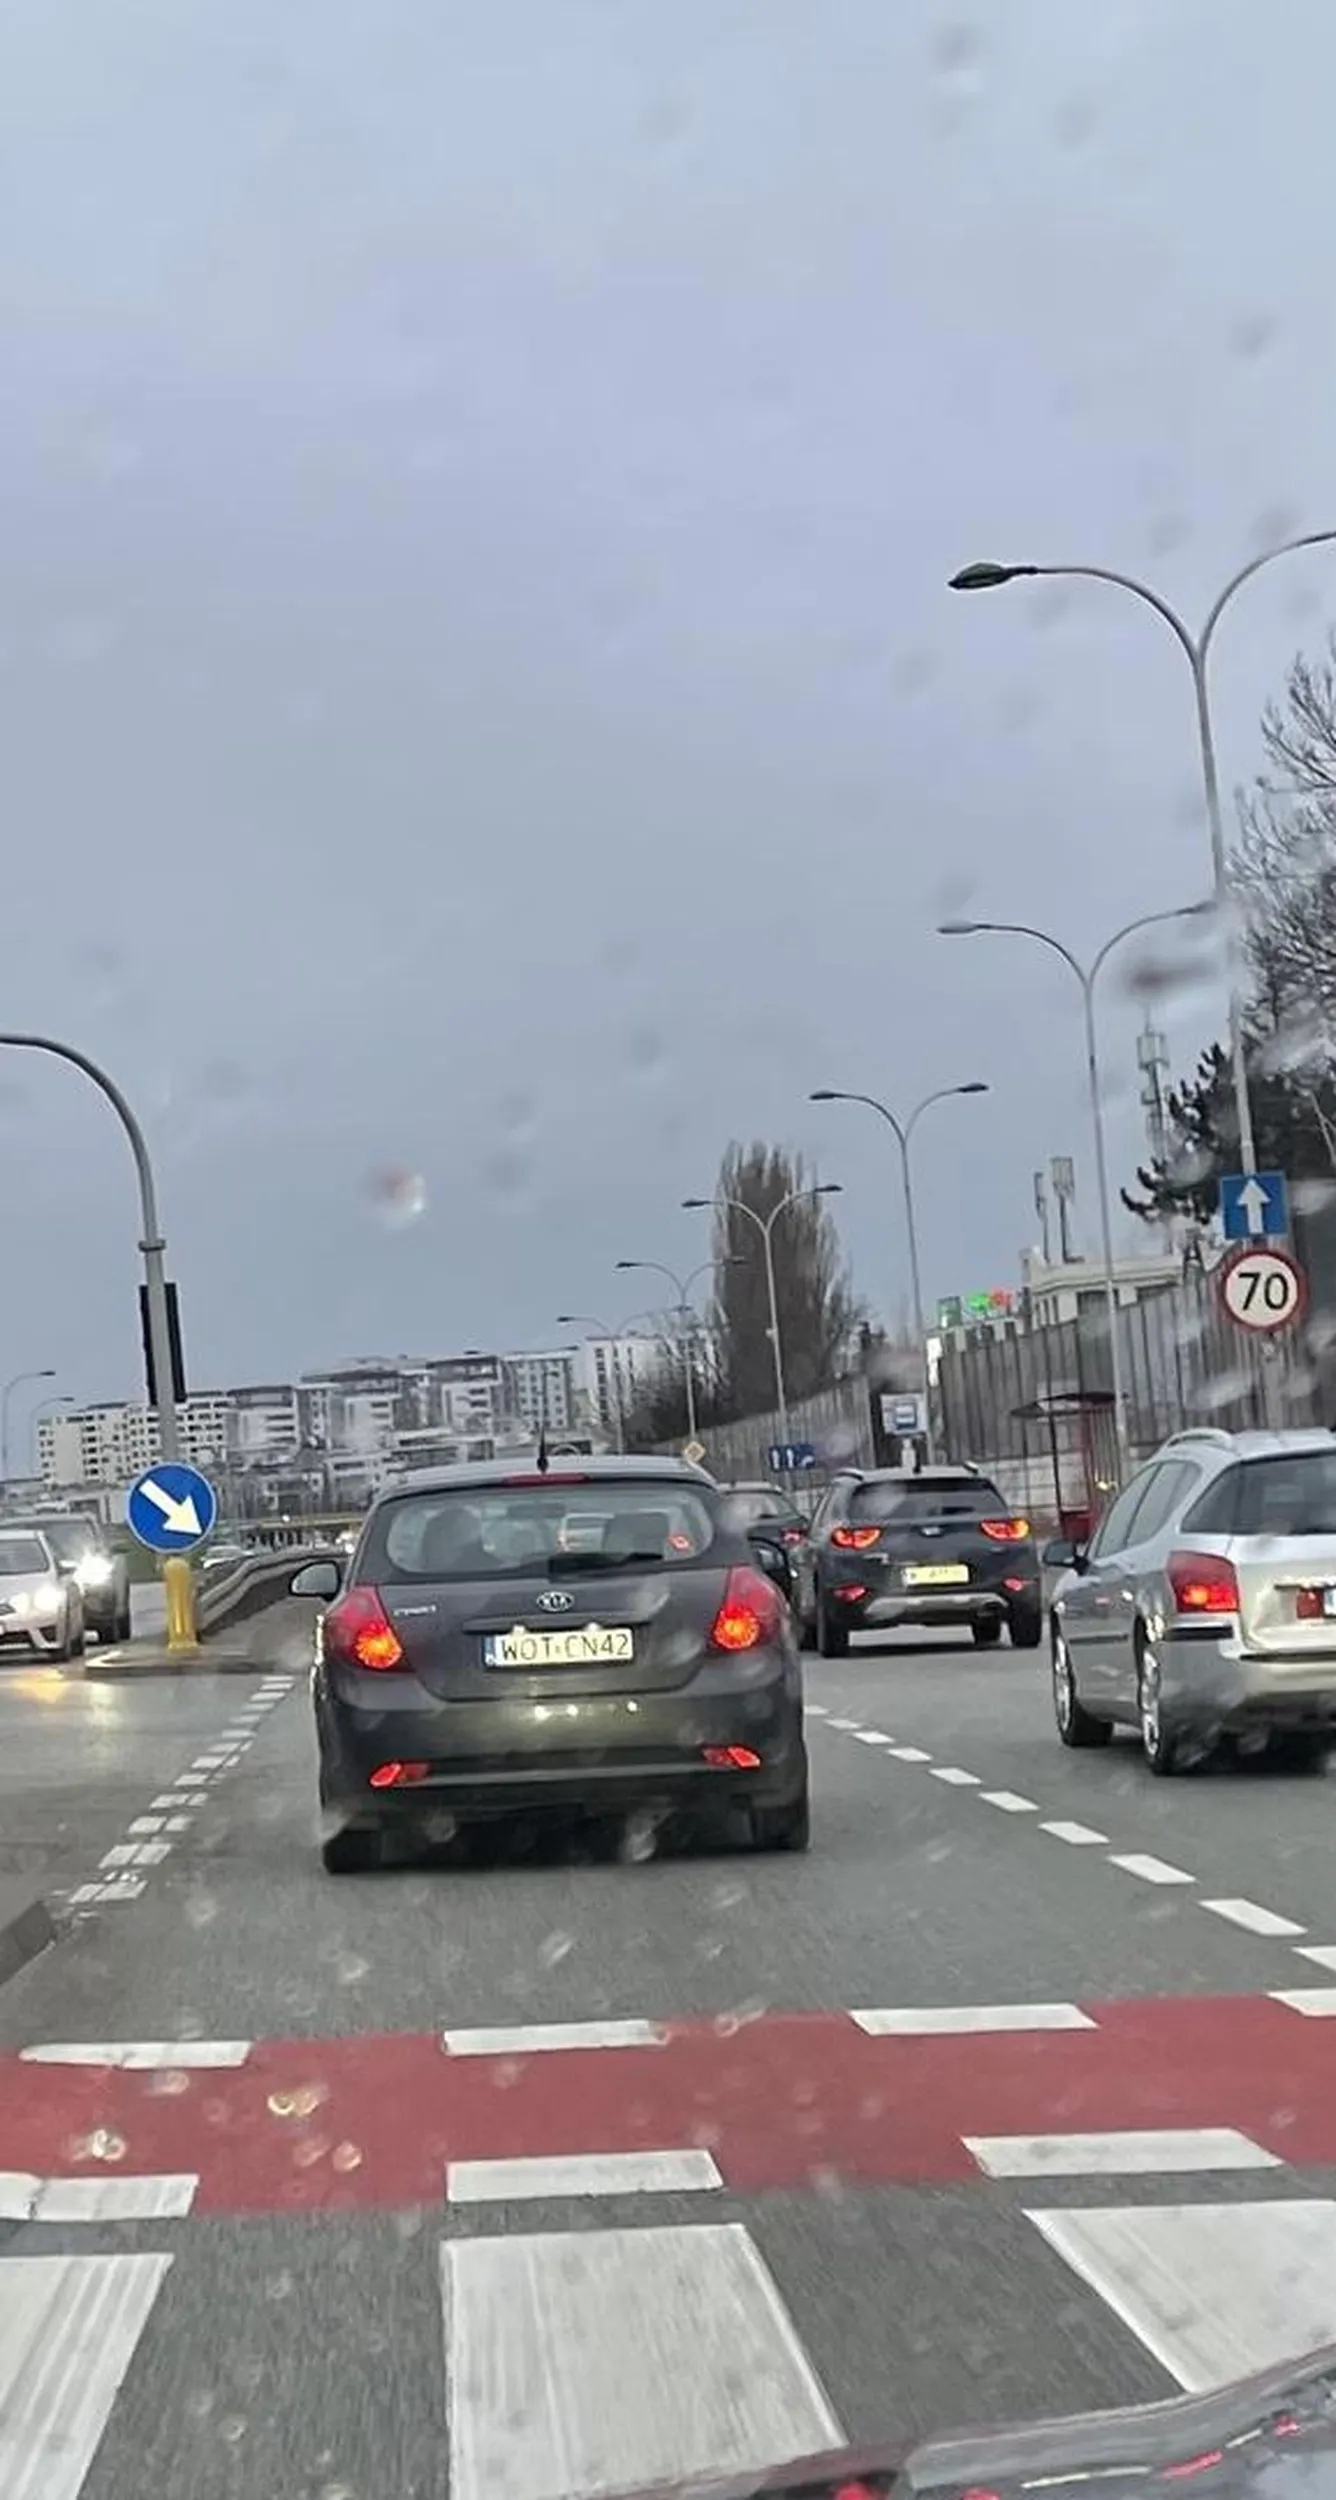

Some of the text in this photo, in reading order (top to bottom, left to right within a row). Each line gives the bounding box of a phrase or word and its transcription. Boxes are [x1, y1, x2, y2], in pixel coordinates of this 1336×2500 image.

[1239, 1272, 1288, 1310] 70
[502, 1633, 629, 1661] WOT CN42
